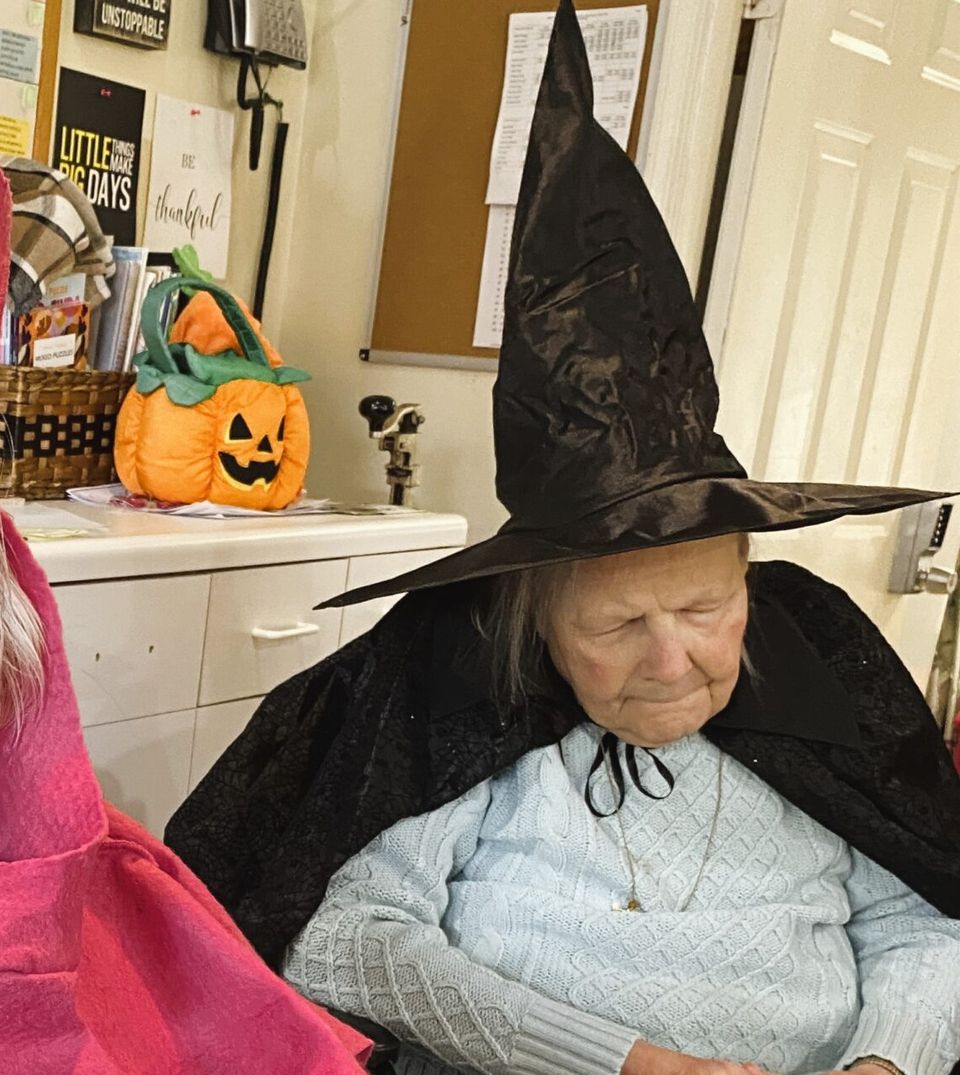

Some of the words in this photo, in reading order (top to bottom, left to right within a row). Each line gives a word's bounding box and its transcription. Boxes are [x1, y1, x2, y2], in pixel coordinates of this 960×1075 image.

[102, 2, 165, 40] UNSTOPPABLE
[60, 125, 112, 171] LITTLE
[109, 153, 134, 176] MAKE
[112, 138, 136, 158] THINGS
[181, 153, 196, 170] BE
[87, 168, 132, 212] DAYS
[154, 183, 224, 241] thankful
